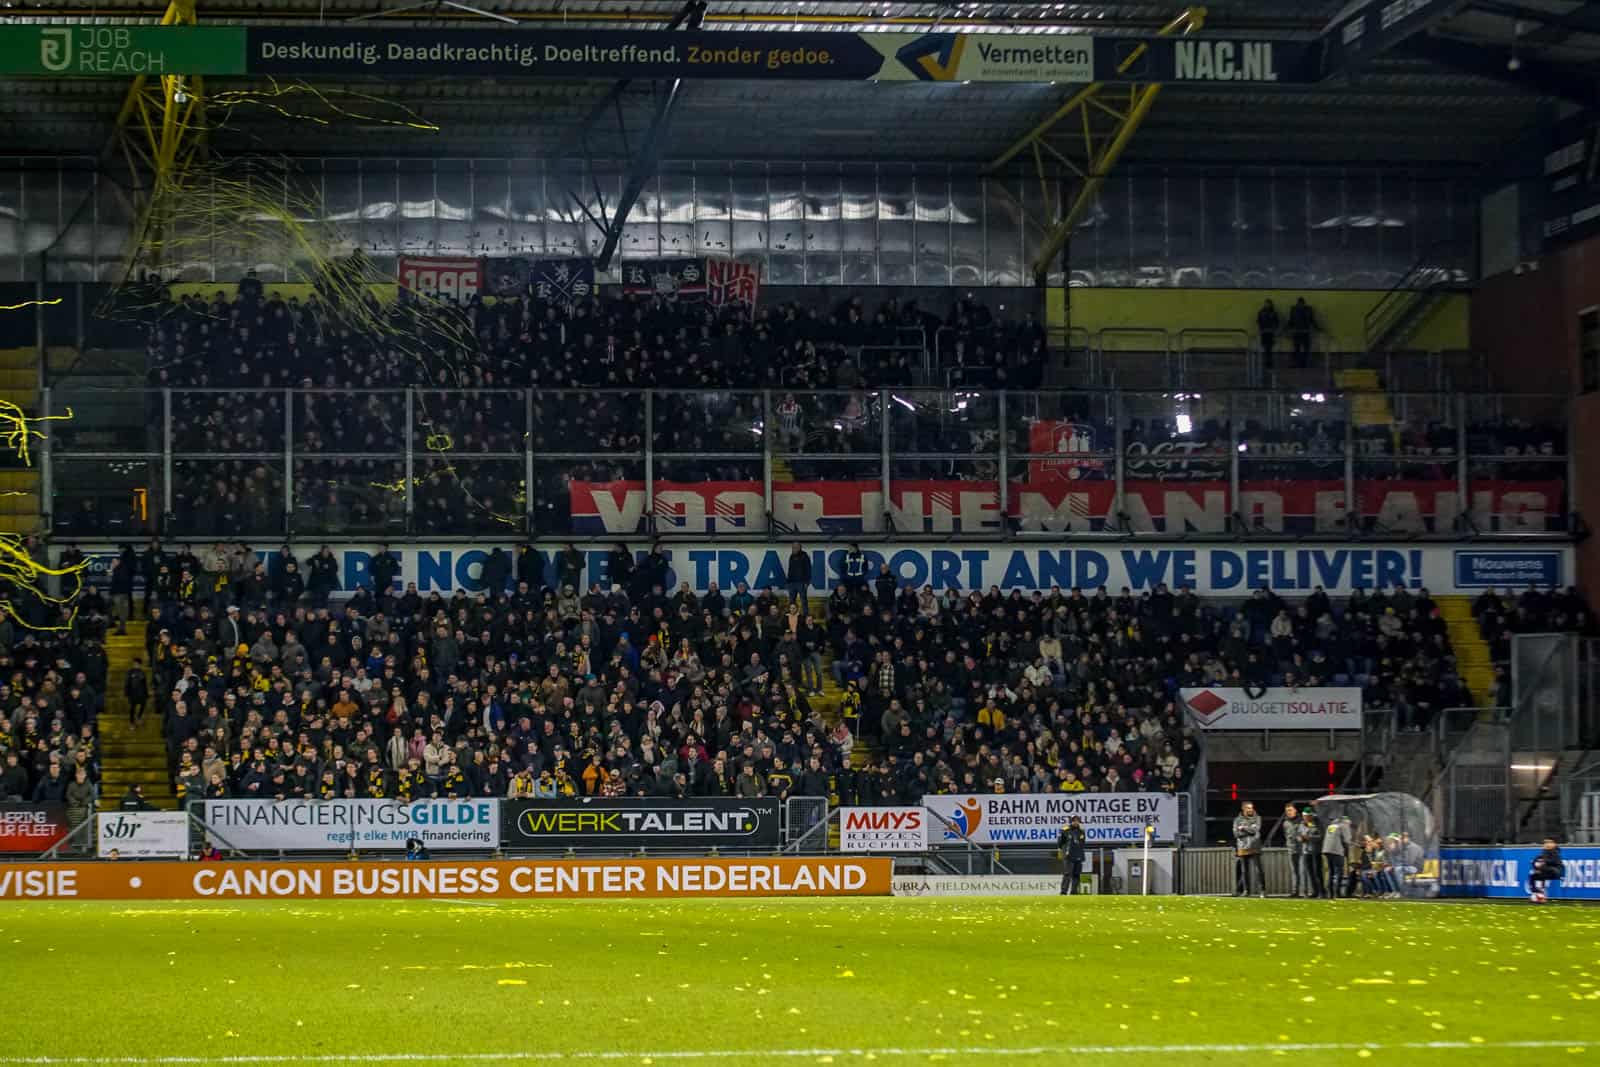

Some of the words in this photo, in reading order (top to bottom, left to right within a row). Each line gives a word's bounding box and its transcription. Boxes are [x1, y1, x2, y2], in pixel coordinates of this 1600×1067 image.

[80, 29, 128, 49] JOB
[80, 51, 164, 72] REACH
[261, 42, 382, 64] Deskundig.
[387, 43, 538, 66] Daadkrachtig.
[544, 44, 681, 64] Doeltreffend.
[687, 46, 761, 64] Zonder
[767, 47, 835, 68] gedoe.
[978, 42, 1089, 64] Vermetten
[1174, 41, 1278, 81] NAC.NL
[590, 490, 823, 533] VOOR
[999, 550, 1110, 590] AND
[1120, 550, 1197, 590] WE
[1210, 550, 1423, 590] DELIVER!
[211, 803, 491, 827] FINANCIERINGSGILDE
[988, 800, 1040, 814] BAHM
[1046, 798, 1130, 814] MONTAGE
[1137, 798, 1160, 812] BV
[103, 816, 142, 838] sbr
[846, 811, 921, 830] MUYS
[988, 815, 1033, 826] ELEKTRO
[1035, 815, 1048, 825] EN
[1050, 814, 1161, 826] INSTLLATIETECHNIEK
[327, 830, 361, 843] regelt
[364, 830, 388, 841] elke
[422, 829, 491, 843] financiering
[847, 841, 922, 849] RUCPHEN
[989, 827, 1161, 842] WWW.BAHONTAGE.L
[192, 868, 323, 896] CANON
[333, 867, 499, 895] BUSINESS
[509, 866, 646, 893] CENTER
[656, 865, 867, 891] NEDERLAND
